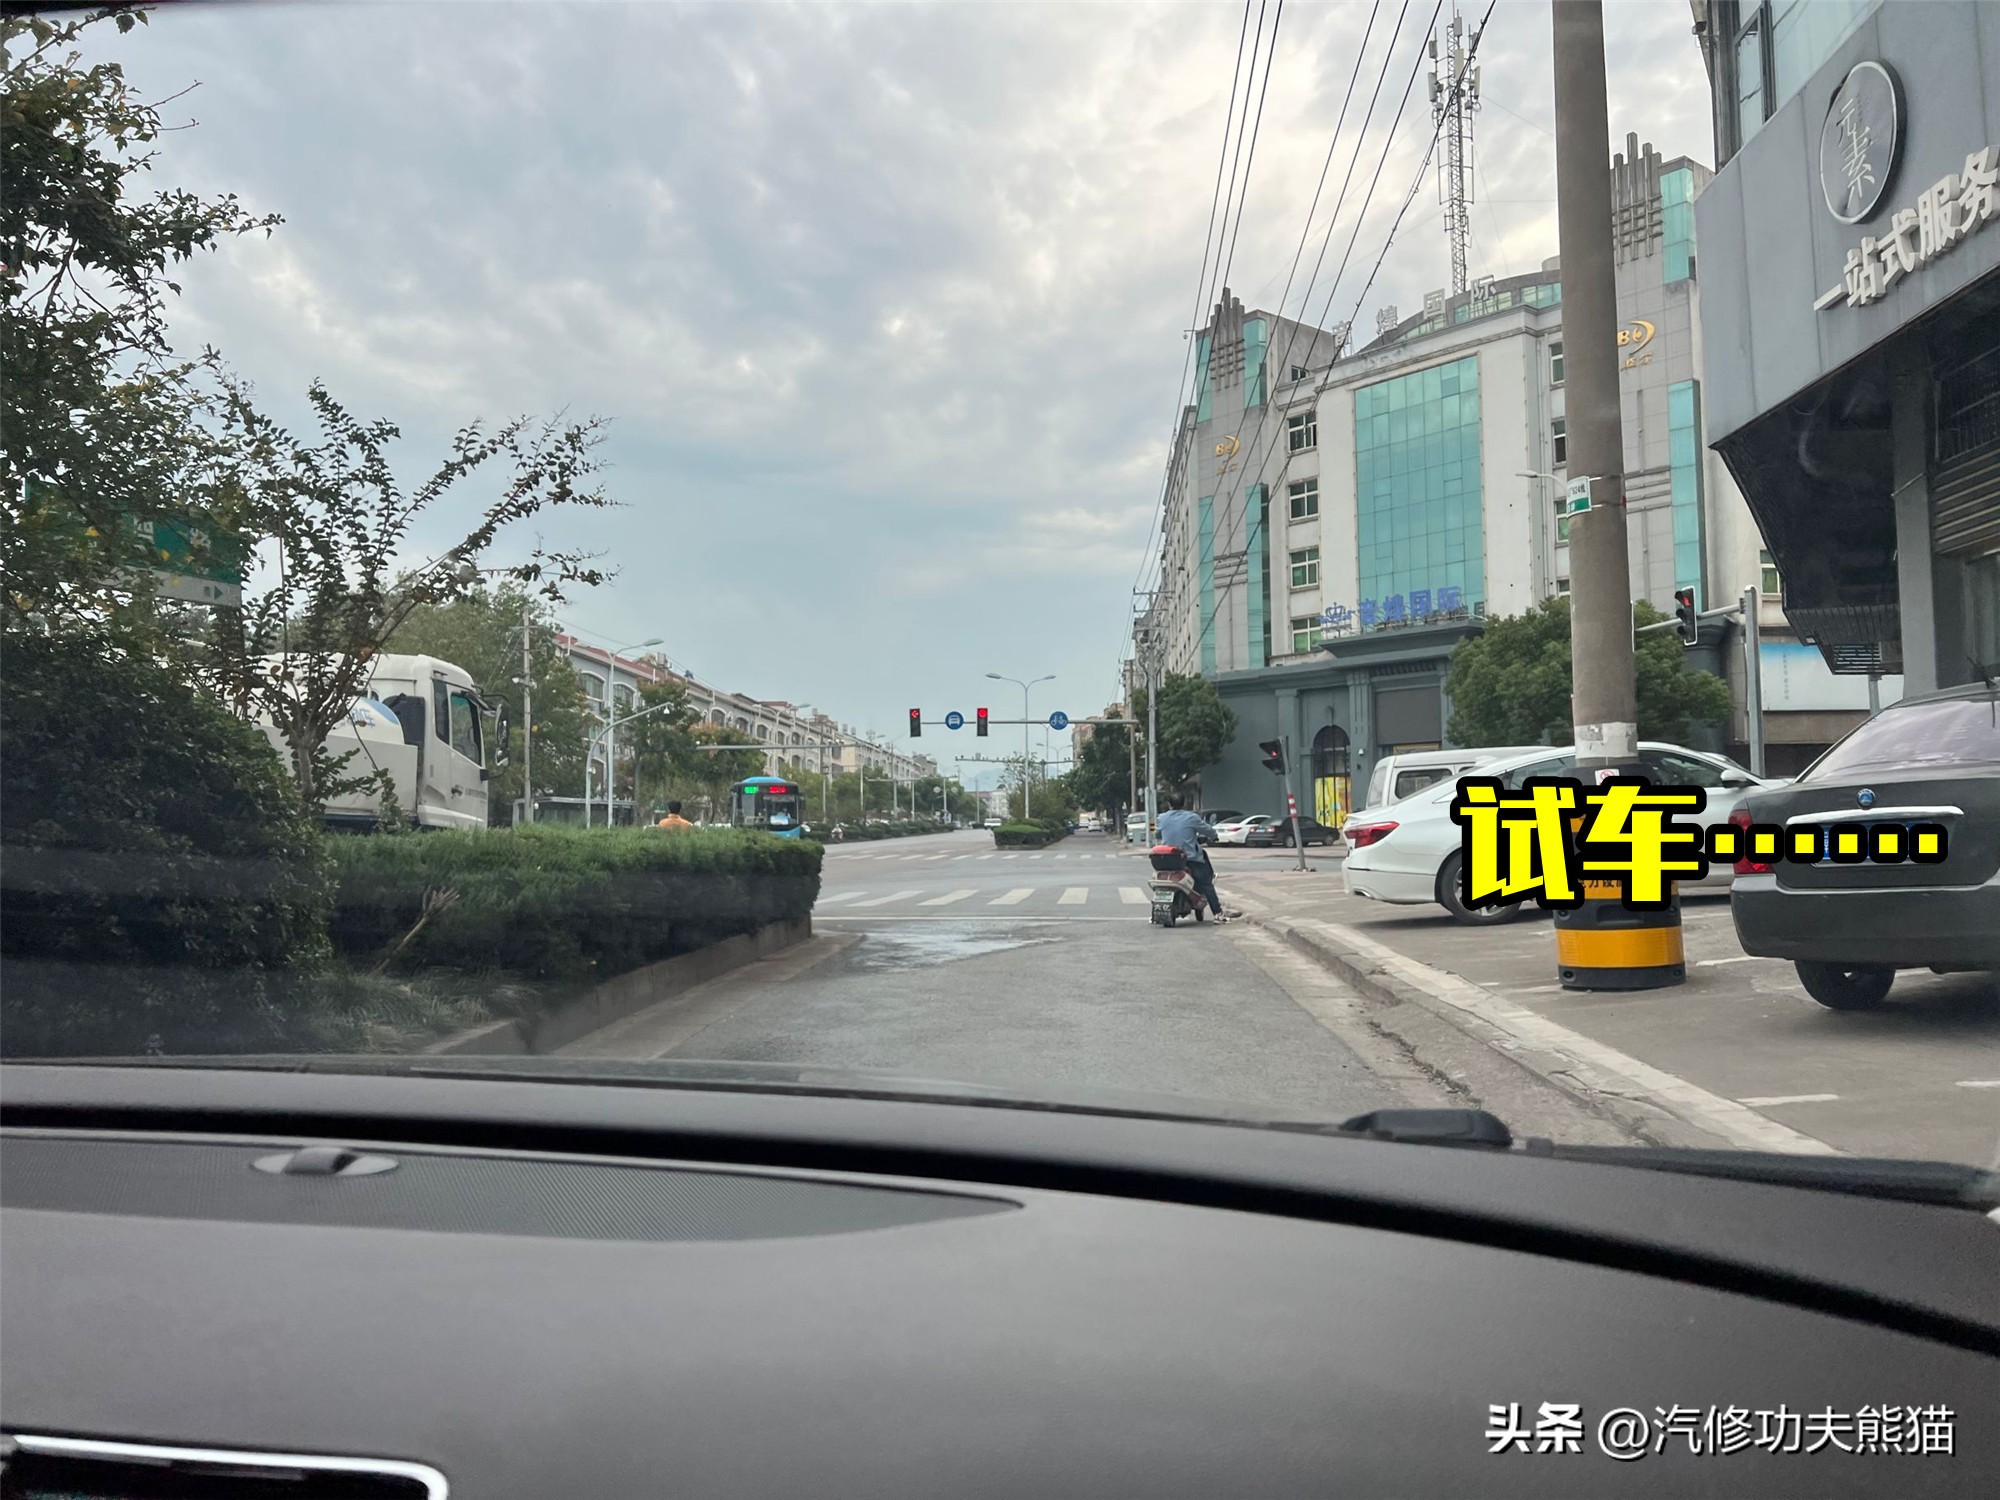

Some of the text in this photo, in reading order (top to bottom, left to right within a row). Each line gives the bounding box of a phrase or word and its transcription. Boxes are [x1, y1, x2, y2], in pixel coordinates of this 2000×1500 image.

[1836, 98, 1875, 209] 元素
[1813, 145, 2000, 311] 一站式服务
